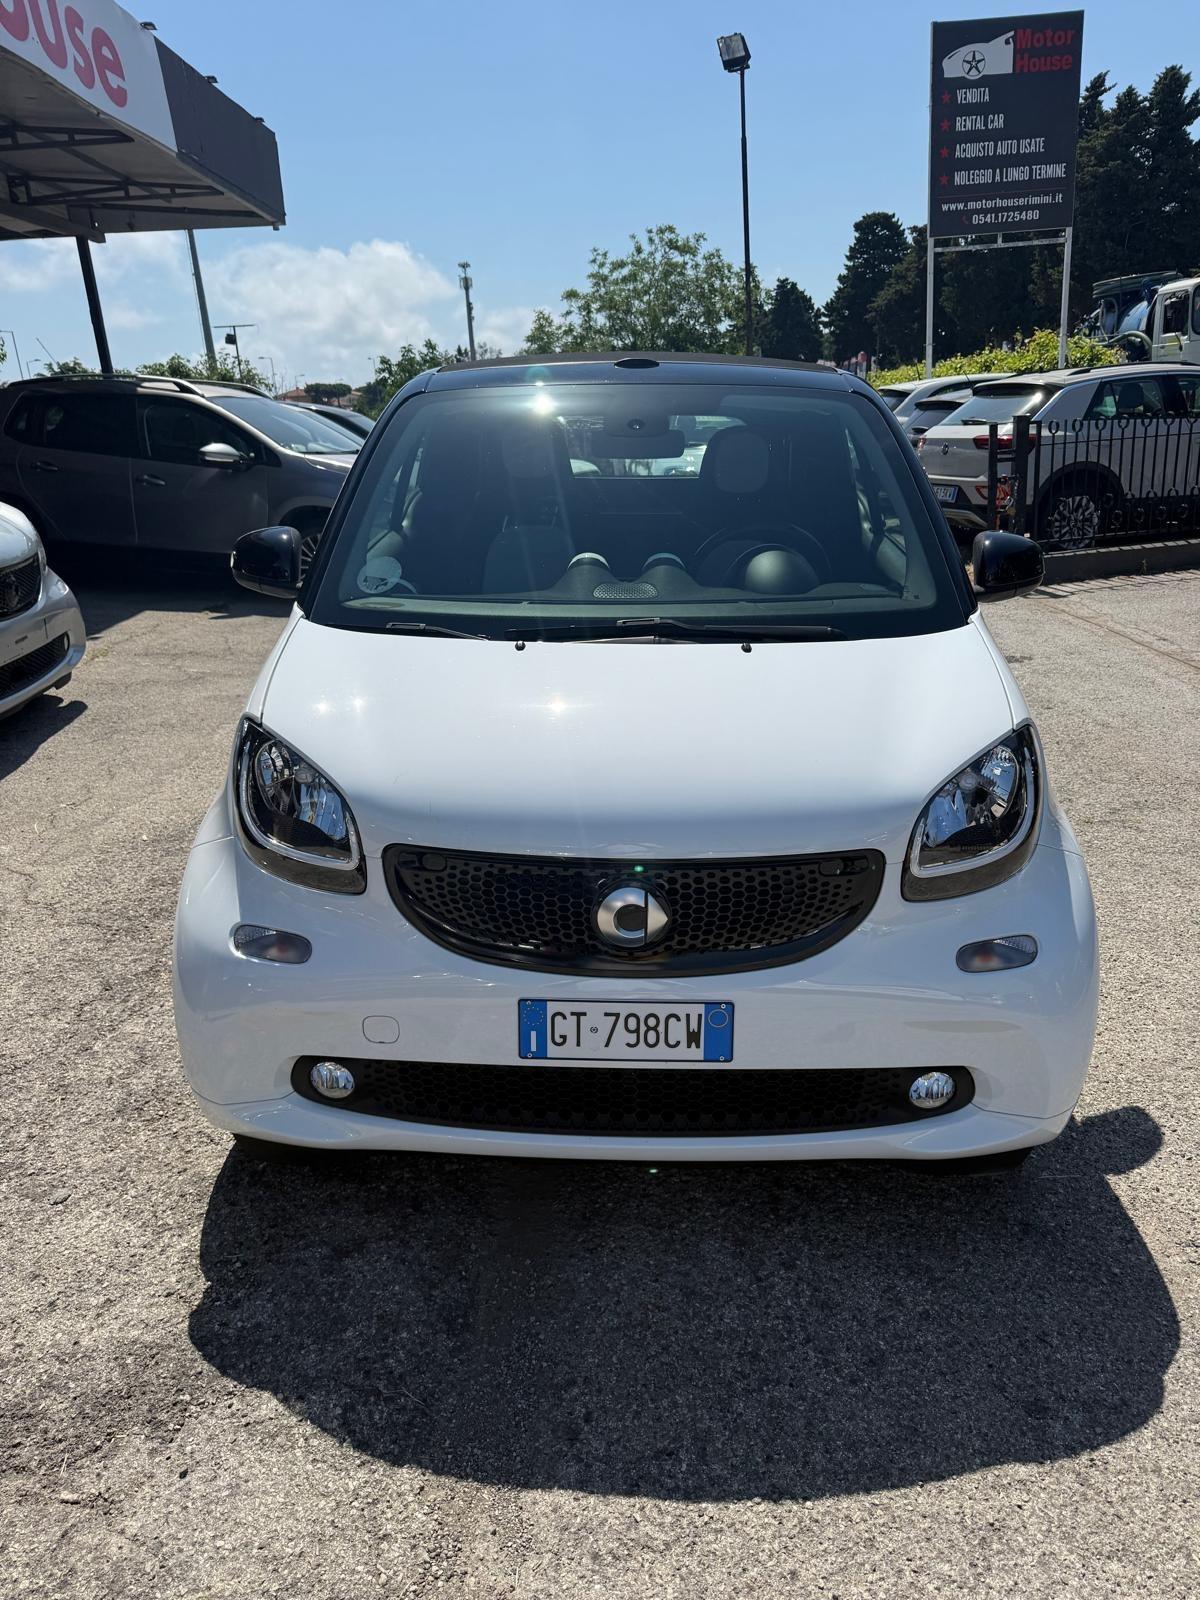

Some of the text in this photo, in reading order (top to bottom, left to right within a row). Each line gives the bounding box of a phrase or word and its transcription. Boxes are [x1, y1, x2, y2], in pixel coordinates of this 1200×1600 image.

[1015, 28, 1075, 49] Motor
[1015, 53, 1073, 74] House
[956, 87, 990, 104] VENDITA
[955, 113, 1005, 132] RENTAL CAR
[954, 137, 1045, 159] ACQUISTO AUTO USATE
[954, 162, 1067, 186] NOLEGGIO A LUNGO TERMINE
[941, 192, 1063, 212] www.motorhouserimini.it
[972, 209, 1040, 225] 0541.1725480
[550, 1011, 588, 1048] GT
[603, 1012, 703, 1049] 798CW
